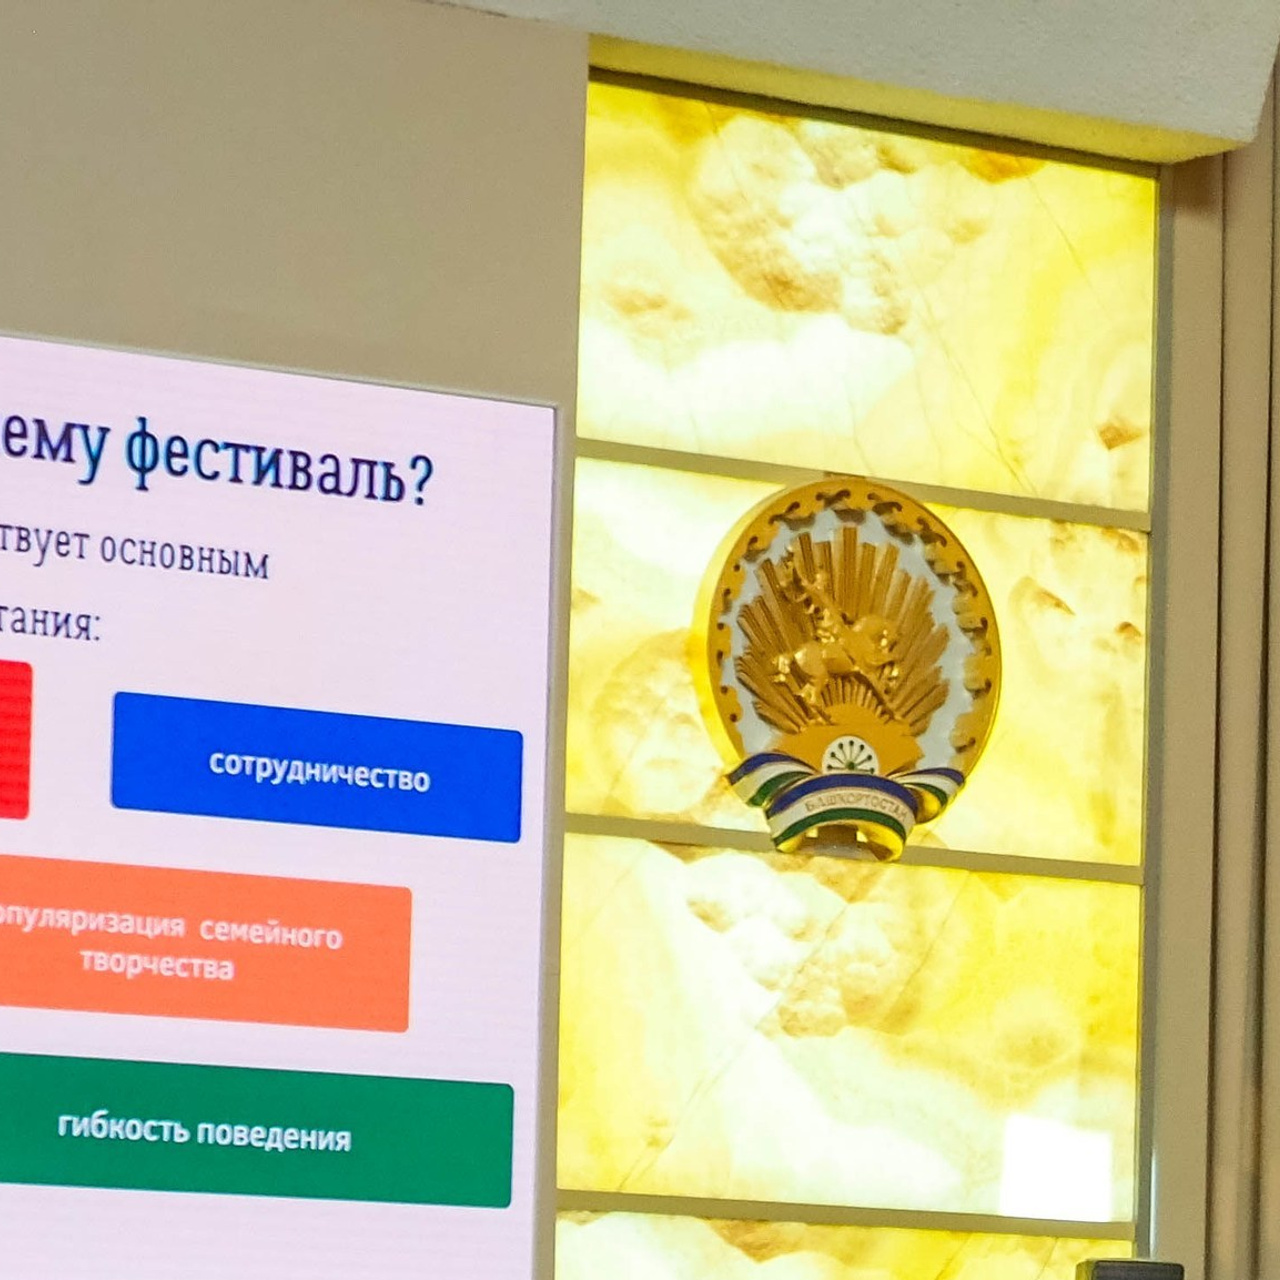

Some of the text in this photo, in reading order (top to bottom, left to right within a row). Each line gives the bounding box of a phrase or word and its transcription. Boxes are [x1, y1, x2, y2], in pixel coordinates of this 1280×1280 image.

[3, 415, 433, 505] ему фестиваль?
[0, 524, 268, 579] твует основным
[210, 753, 430, 792] сотрудничество
[200, 920, 343, 949] семейного
[80, 951, 234, 980] творчества
[59, 1109, 351, 1152] гибкость поведения
